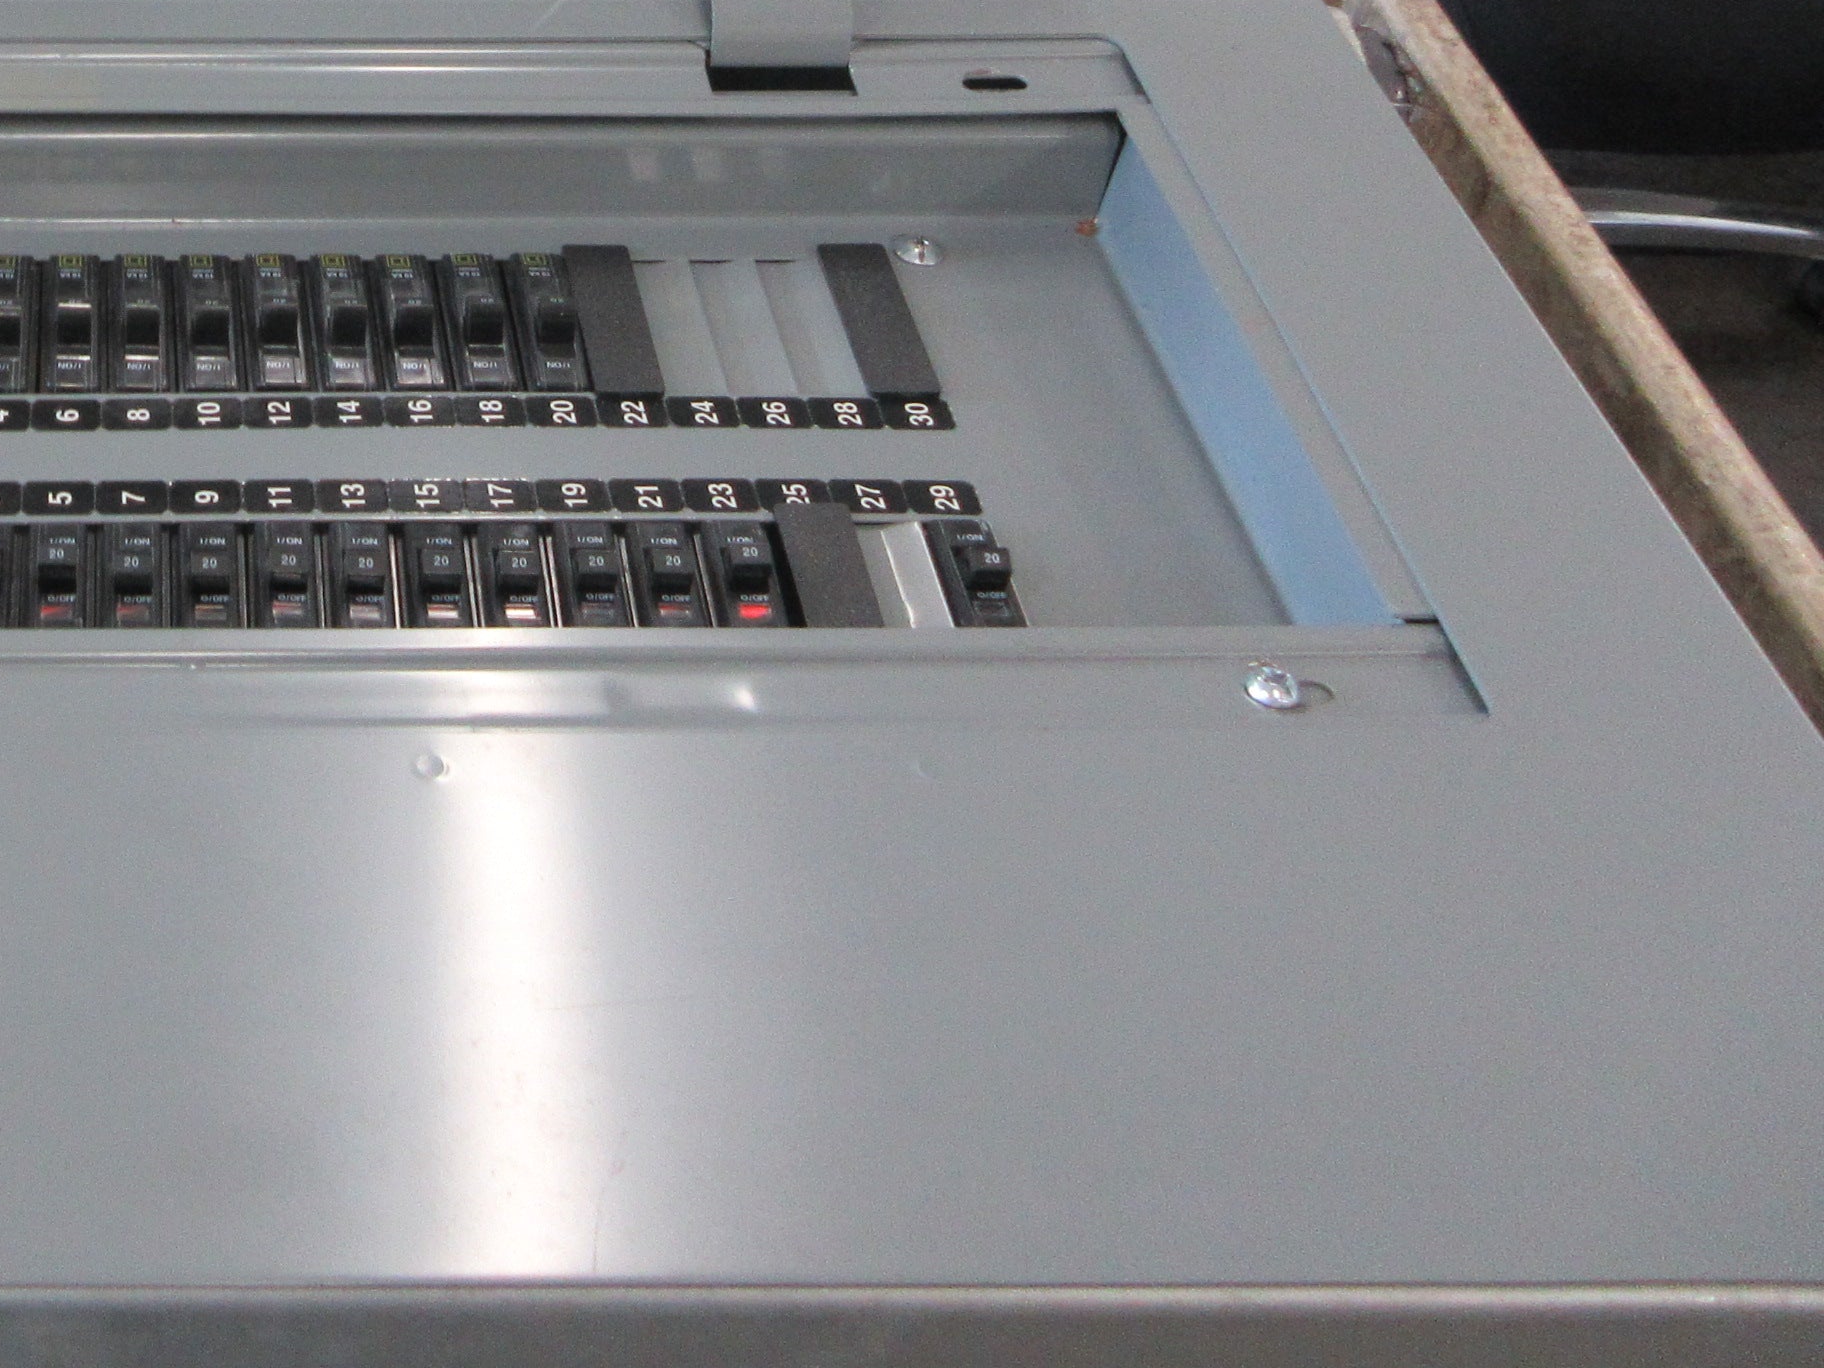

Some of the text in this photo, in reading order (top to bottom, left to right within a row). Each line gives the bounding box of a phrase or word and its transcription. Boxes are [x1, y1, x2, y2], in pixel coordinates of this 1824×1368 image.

[55, 409, 80, 422] 6
[126, 408, 151, 422] 8
[196, 401, 221, 426] 10
[267, 401, 292, 425] 12
[336, 400, 362, 424] 14
[407, 399, 434, 424] 16
[478, 399, 505, 423] 18
[549, 399, 577, 424] 20
[620, 400, 649, 424] 22
[690, 400, 719, 425] 24
[761, 401, 792, 425] 26
[833, 402, 863, 426] 28
[904, 402, 934, 426] 30
[48, 491, 73, 505] 5
[121, 490, 146, 505] 7
[194, 490, 219, 504] 9
[267, 486, 293, 508] 11
[340, 483, 366, 509] 13
[414, 482, 442, 509] 15
[487, 482, 514, 508] 17
[561, 482, 589, 508] 19
[633, 485, 664, 509] 21
[707, 483, 738, 509] 23
[854, 483, 887, 510] 27
[929, 485, 961, 511] 29
[49, 548, 65, 560] 20
[123, 556, 139, 568] 20
[202, 557, 218, 569] 20
[281, 555, 297, 566] 20
[358, 557, 374, 569] 20
[433, 556, 449, 567] 20
[511, 557, 527, 568] 20
[588, 555, 604, 566] 20
[665, 555, 681, 566] 20
[742, 547, 759, 557] 20
[984, 553, 1000, 564] 20
